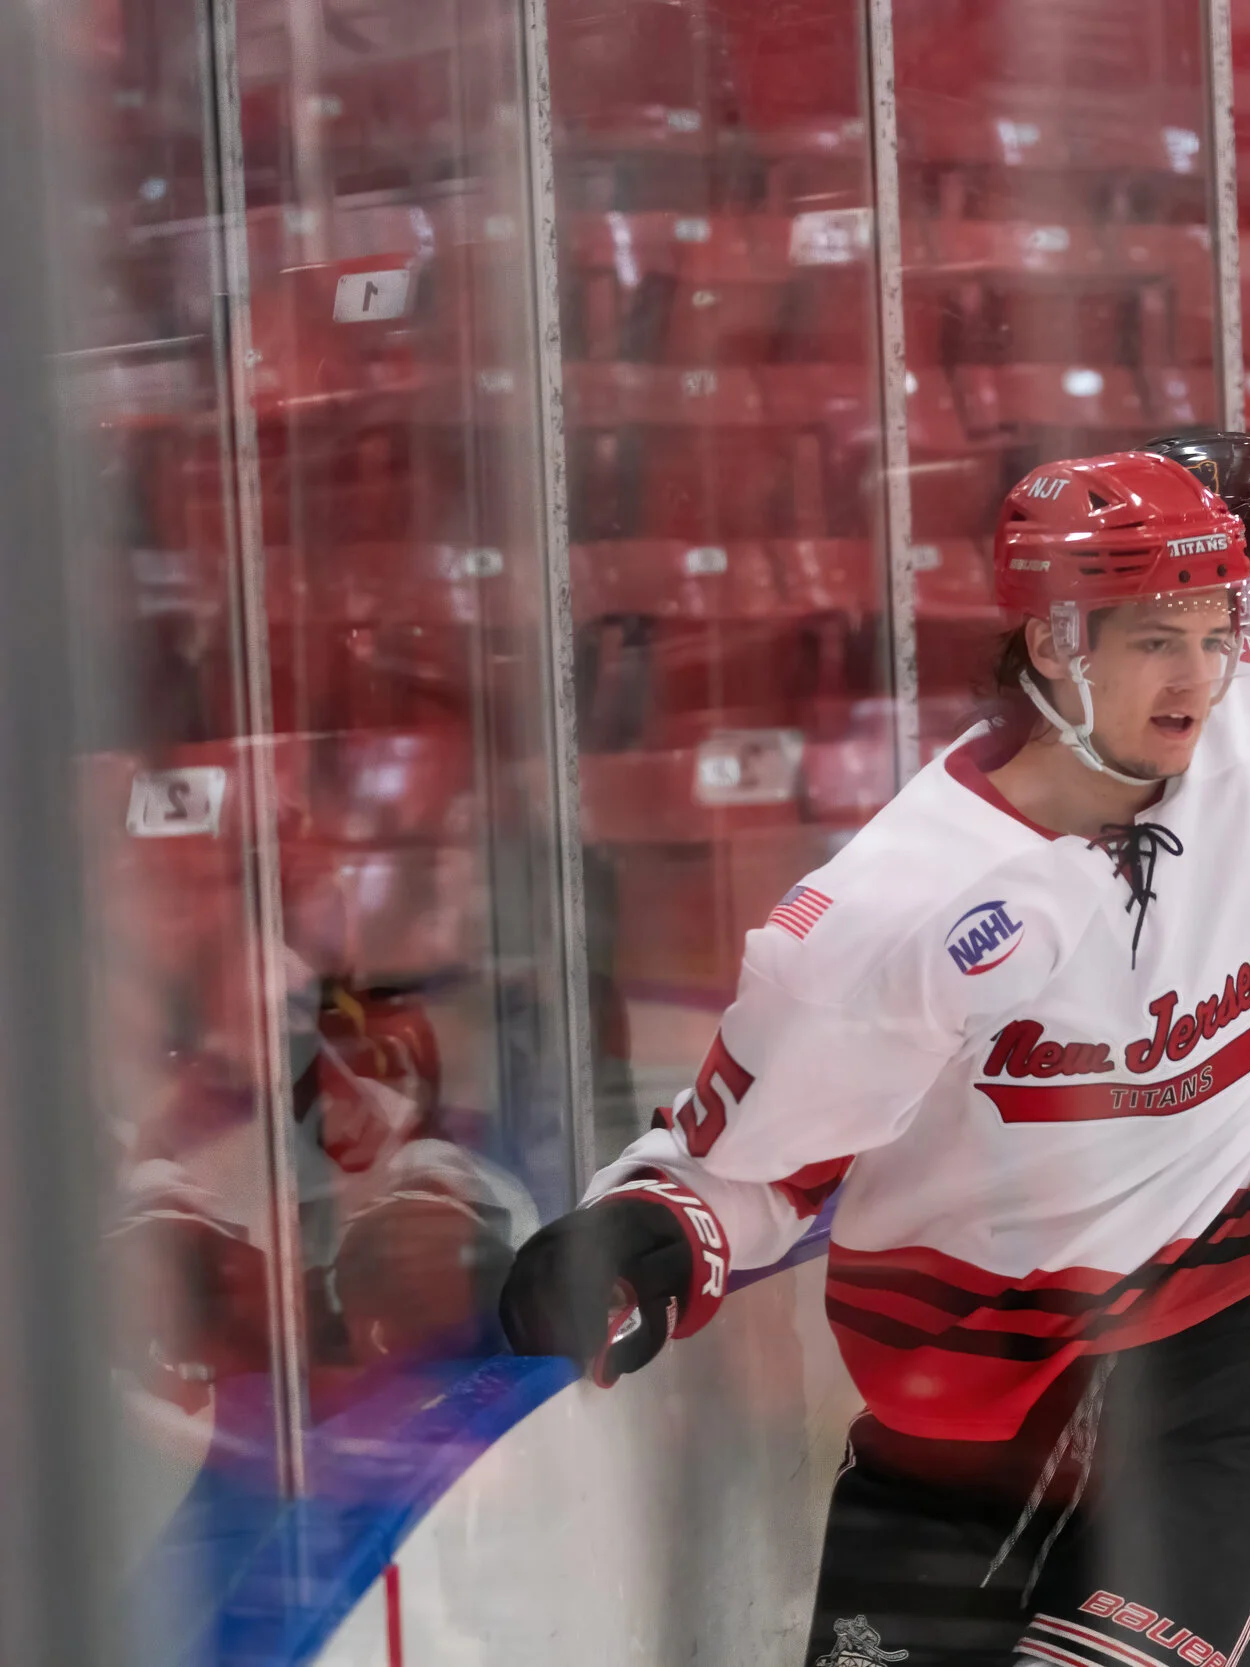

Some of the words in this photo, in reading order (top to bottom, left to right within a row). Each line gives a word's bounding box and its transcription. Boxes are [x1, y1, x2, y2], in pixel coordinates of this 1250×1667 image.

[1027, 477, 1071, 500] NJT
[1167, 533, 1228, 557] TITANS
[948, 906, 1023, 975] NAHL
[983, 1019, 1115, 1078] New
[1110, 1065, 1213, 1109] TITANS
